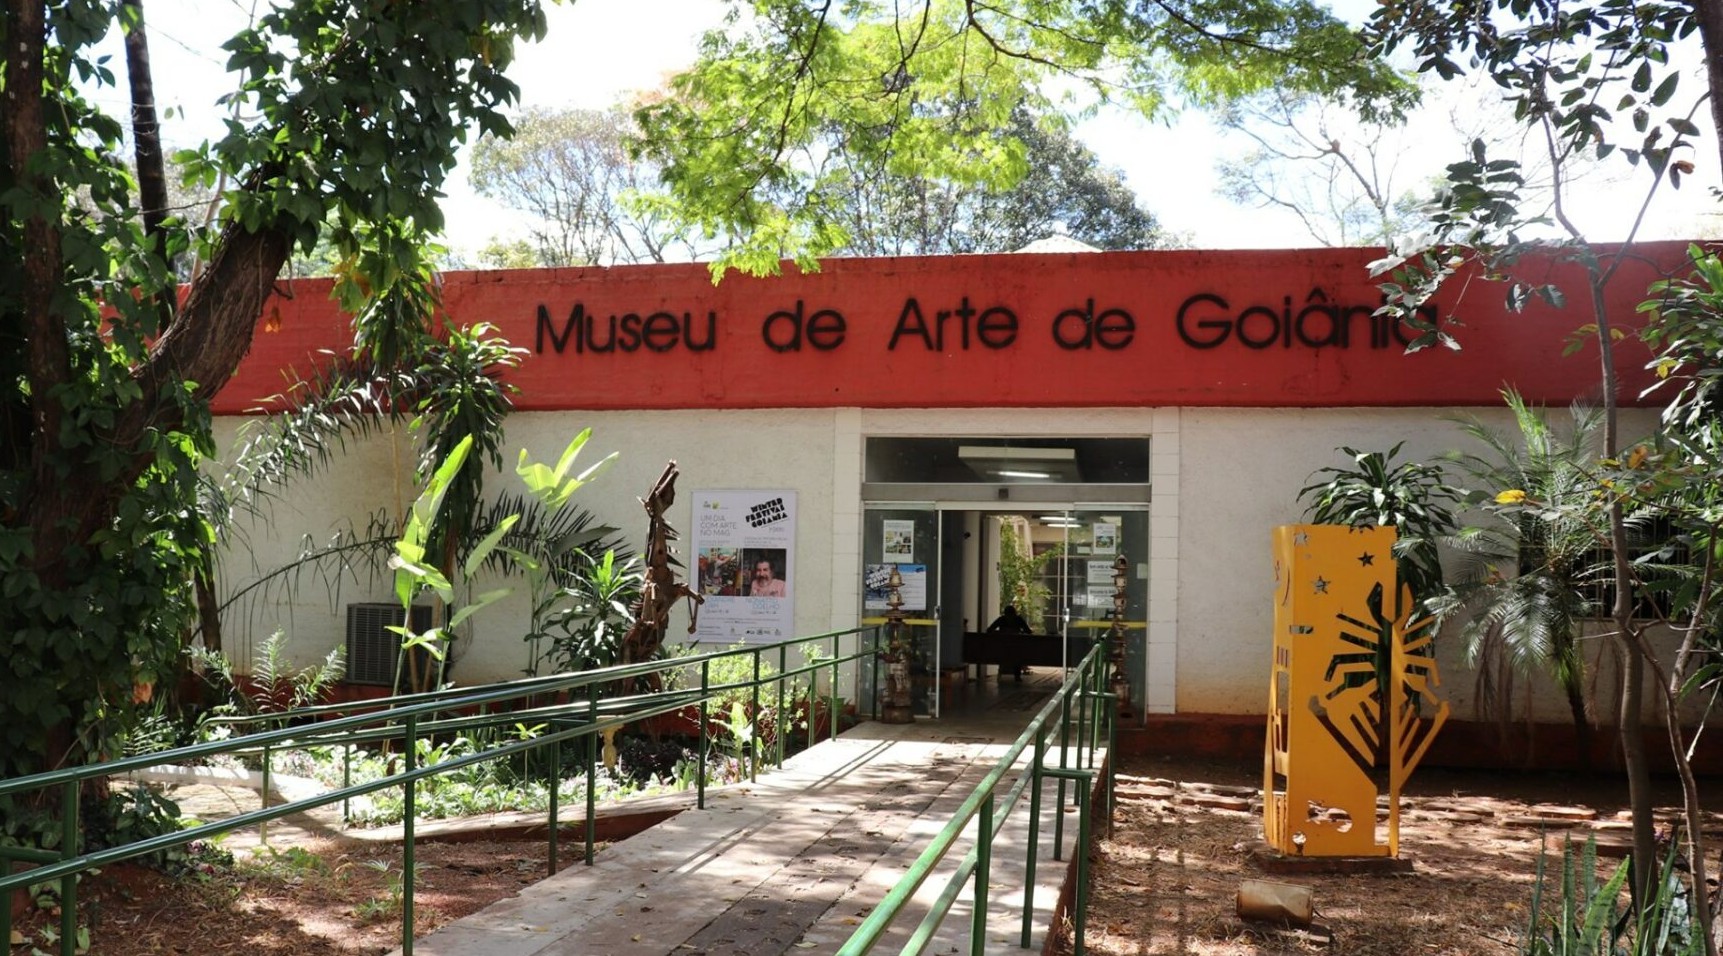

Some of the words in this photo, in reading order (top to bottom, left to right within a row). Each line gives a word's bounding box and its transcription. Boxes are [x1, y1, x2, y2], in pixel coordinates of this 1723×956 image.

[535, 303, 717, 355] Museu
[762, 299, 847, 354] de
[887, 296, 1019, 352] Arte
[1052, 298, 1136, 351] de
[1176, 287, 1438, 351] Goiânia
[745, 504, 785, 523] FESTIVAL
